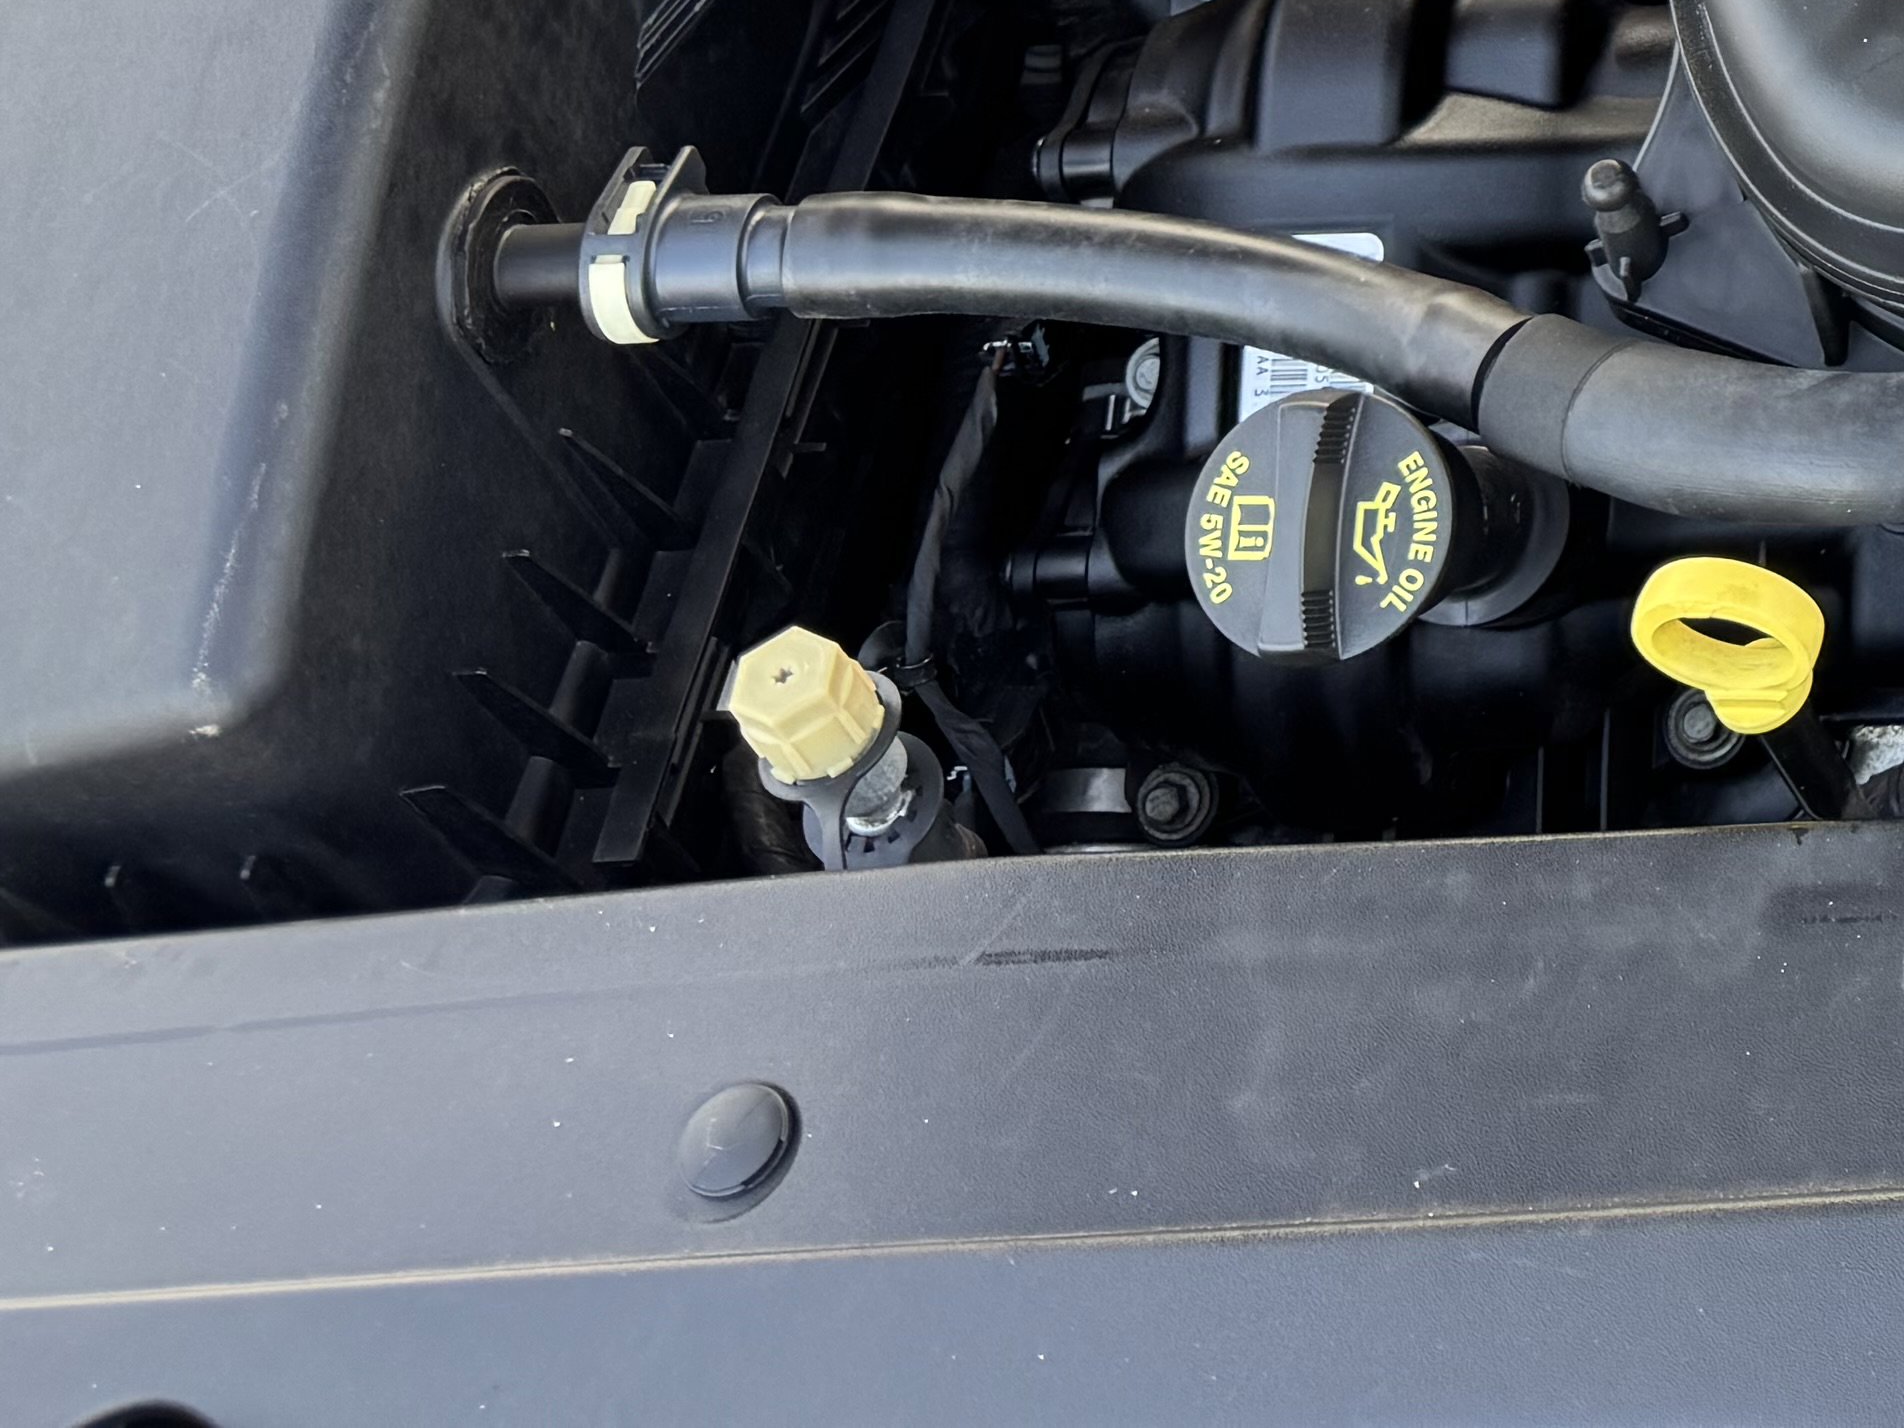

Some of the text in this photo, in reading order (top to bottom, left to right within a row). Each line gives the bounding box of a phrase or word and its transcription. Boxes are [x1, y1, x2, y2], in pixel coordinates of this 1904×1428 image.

[1198, 450, 1250, 605] SAE 5W-20
[1379, 450, 1440, 613] ENGINE OIL
